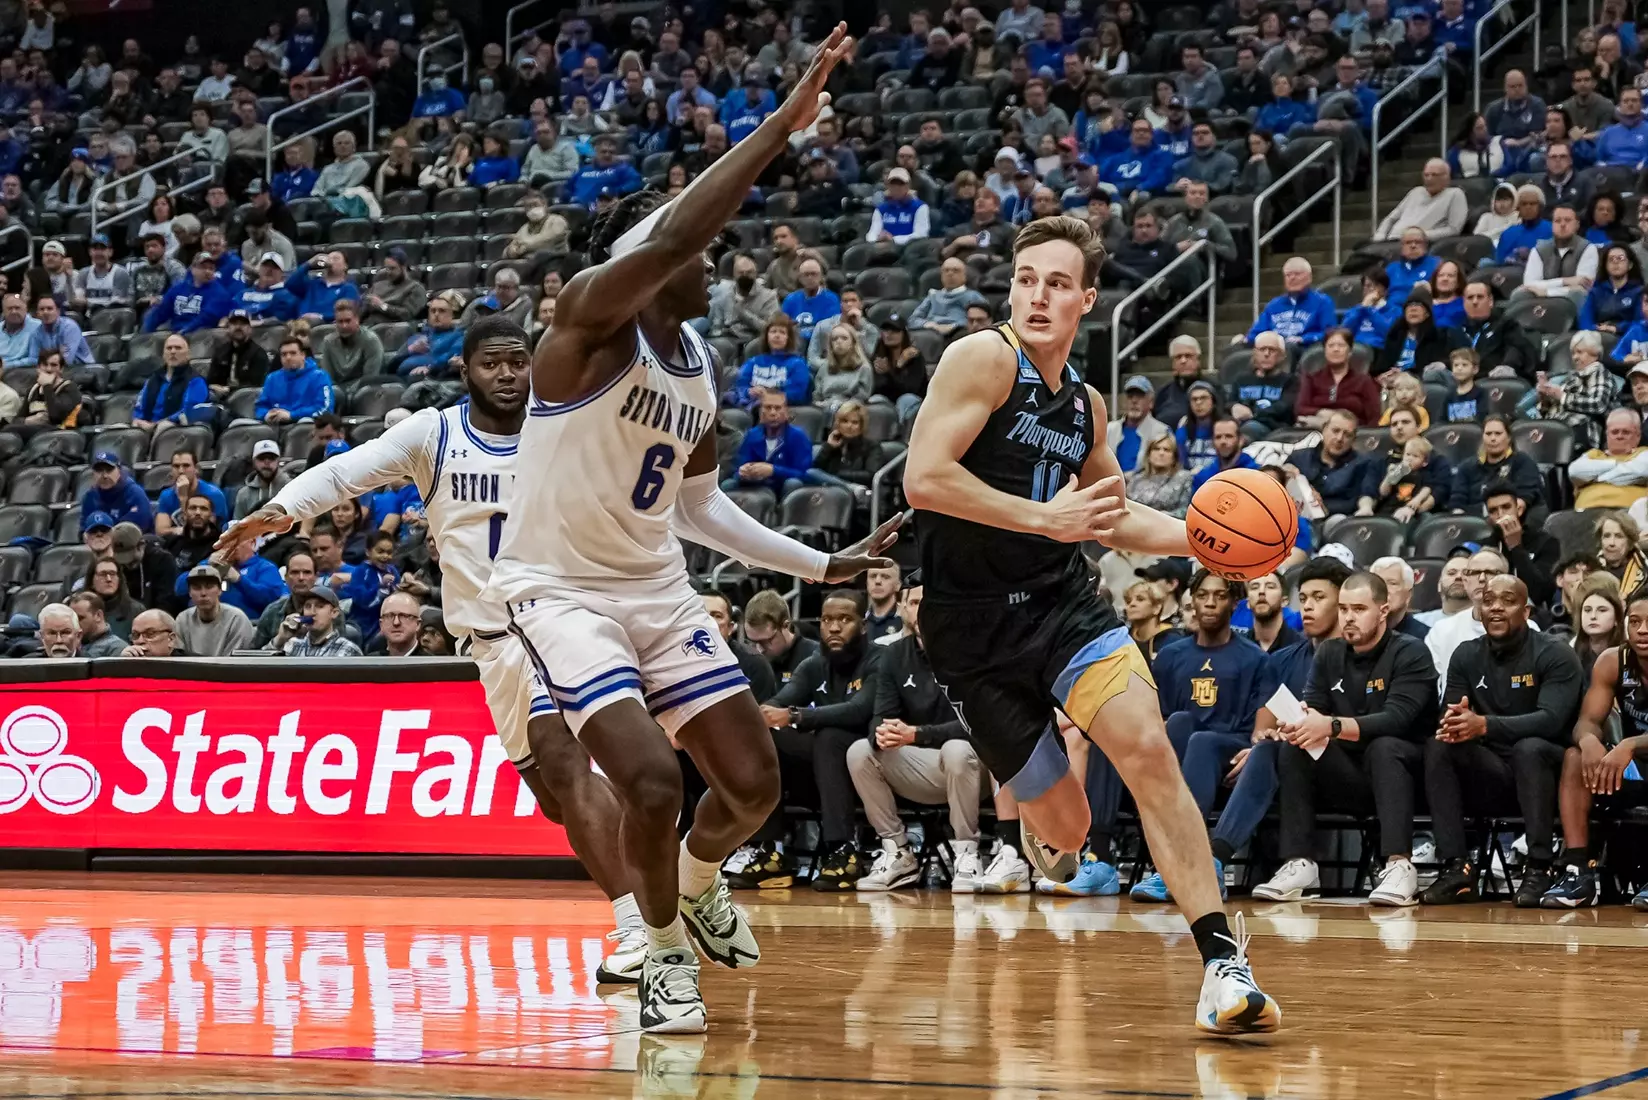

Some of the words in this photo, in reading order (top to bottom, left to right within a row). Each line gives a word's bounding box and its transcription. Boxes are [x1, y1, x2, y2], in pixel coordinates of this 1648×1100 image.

[1006, 410, 1086, 462] Marquette
[451, 472, 499, 503] SETON
[632, 442, 675, 511] 6
[1030, 459, 1062, 502] 11
[1193, 527, 1232, 555] EVO
[1190, 677, 1218, 708] MU
[112, 706, 359, 816] State
[364, 708, 539, 817] Far
